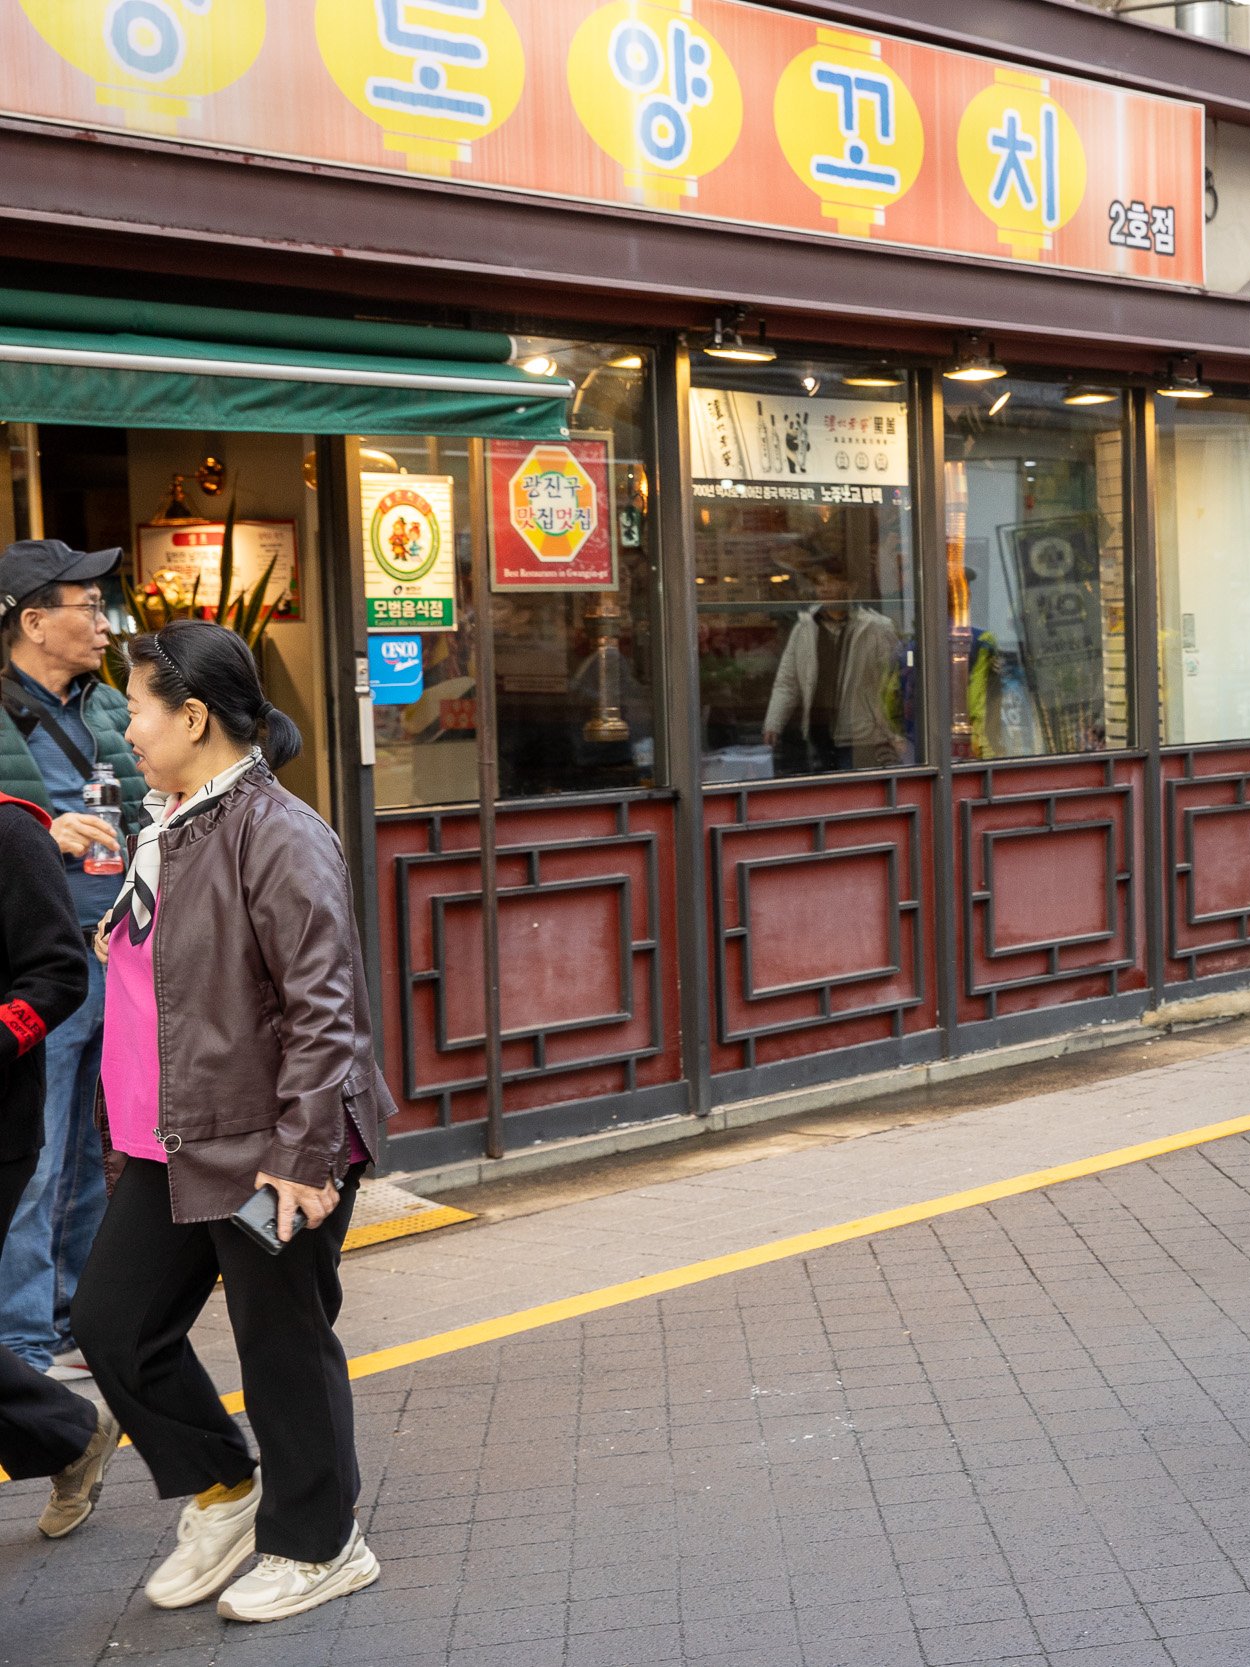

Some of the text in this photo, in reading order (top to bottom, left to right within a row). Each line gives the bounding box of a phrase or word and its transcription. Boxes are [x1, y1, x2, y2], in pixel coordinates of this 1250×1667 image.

[1108, 200, 1177, 256] 2호점
[521, 475, 582, 500] 광진구
[763, 486, 779, 500] 중국
[373, 600, 444, 619] 모범음식점
[381, 641, 418, 658] CESCO
